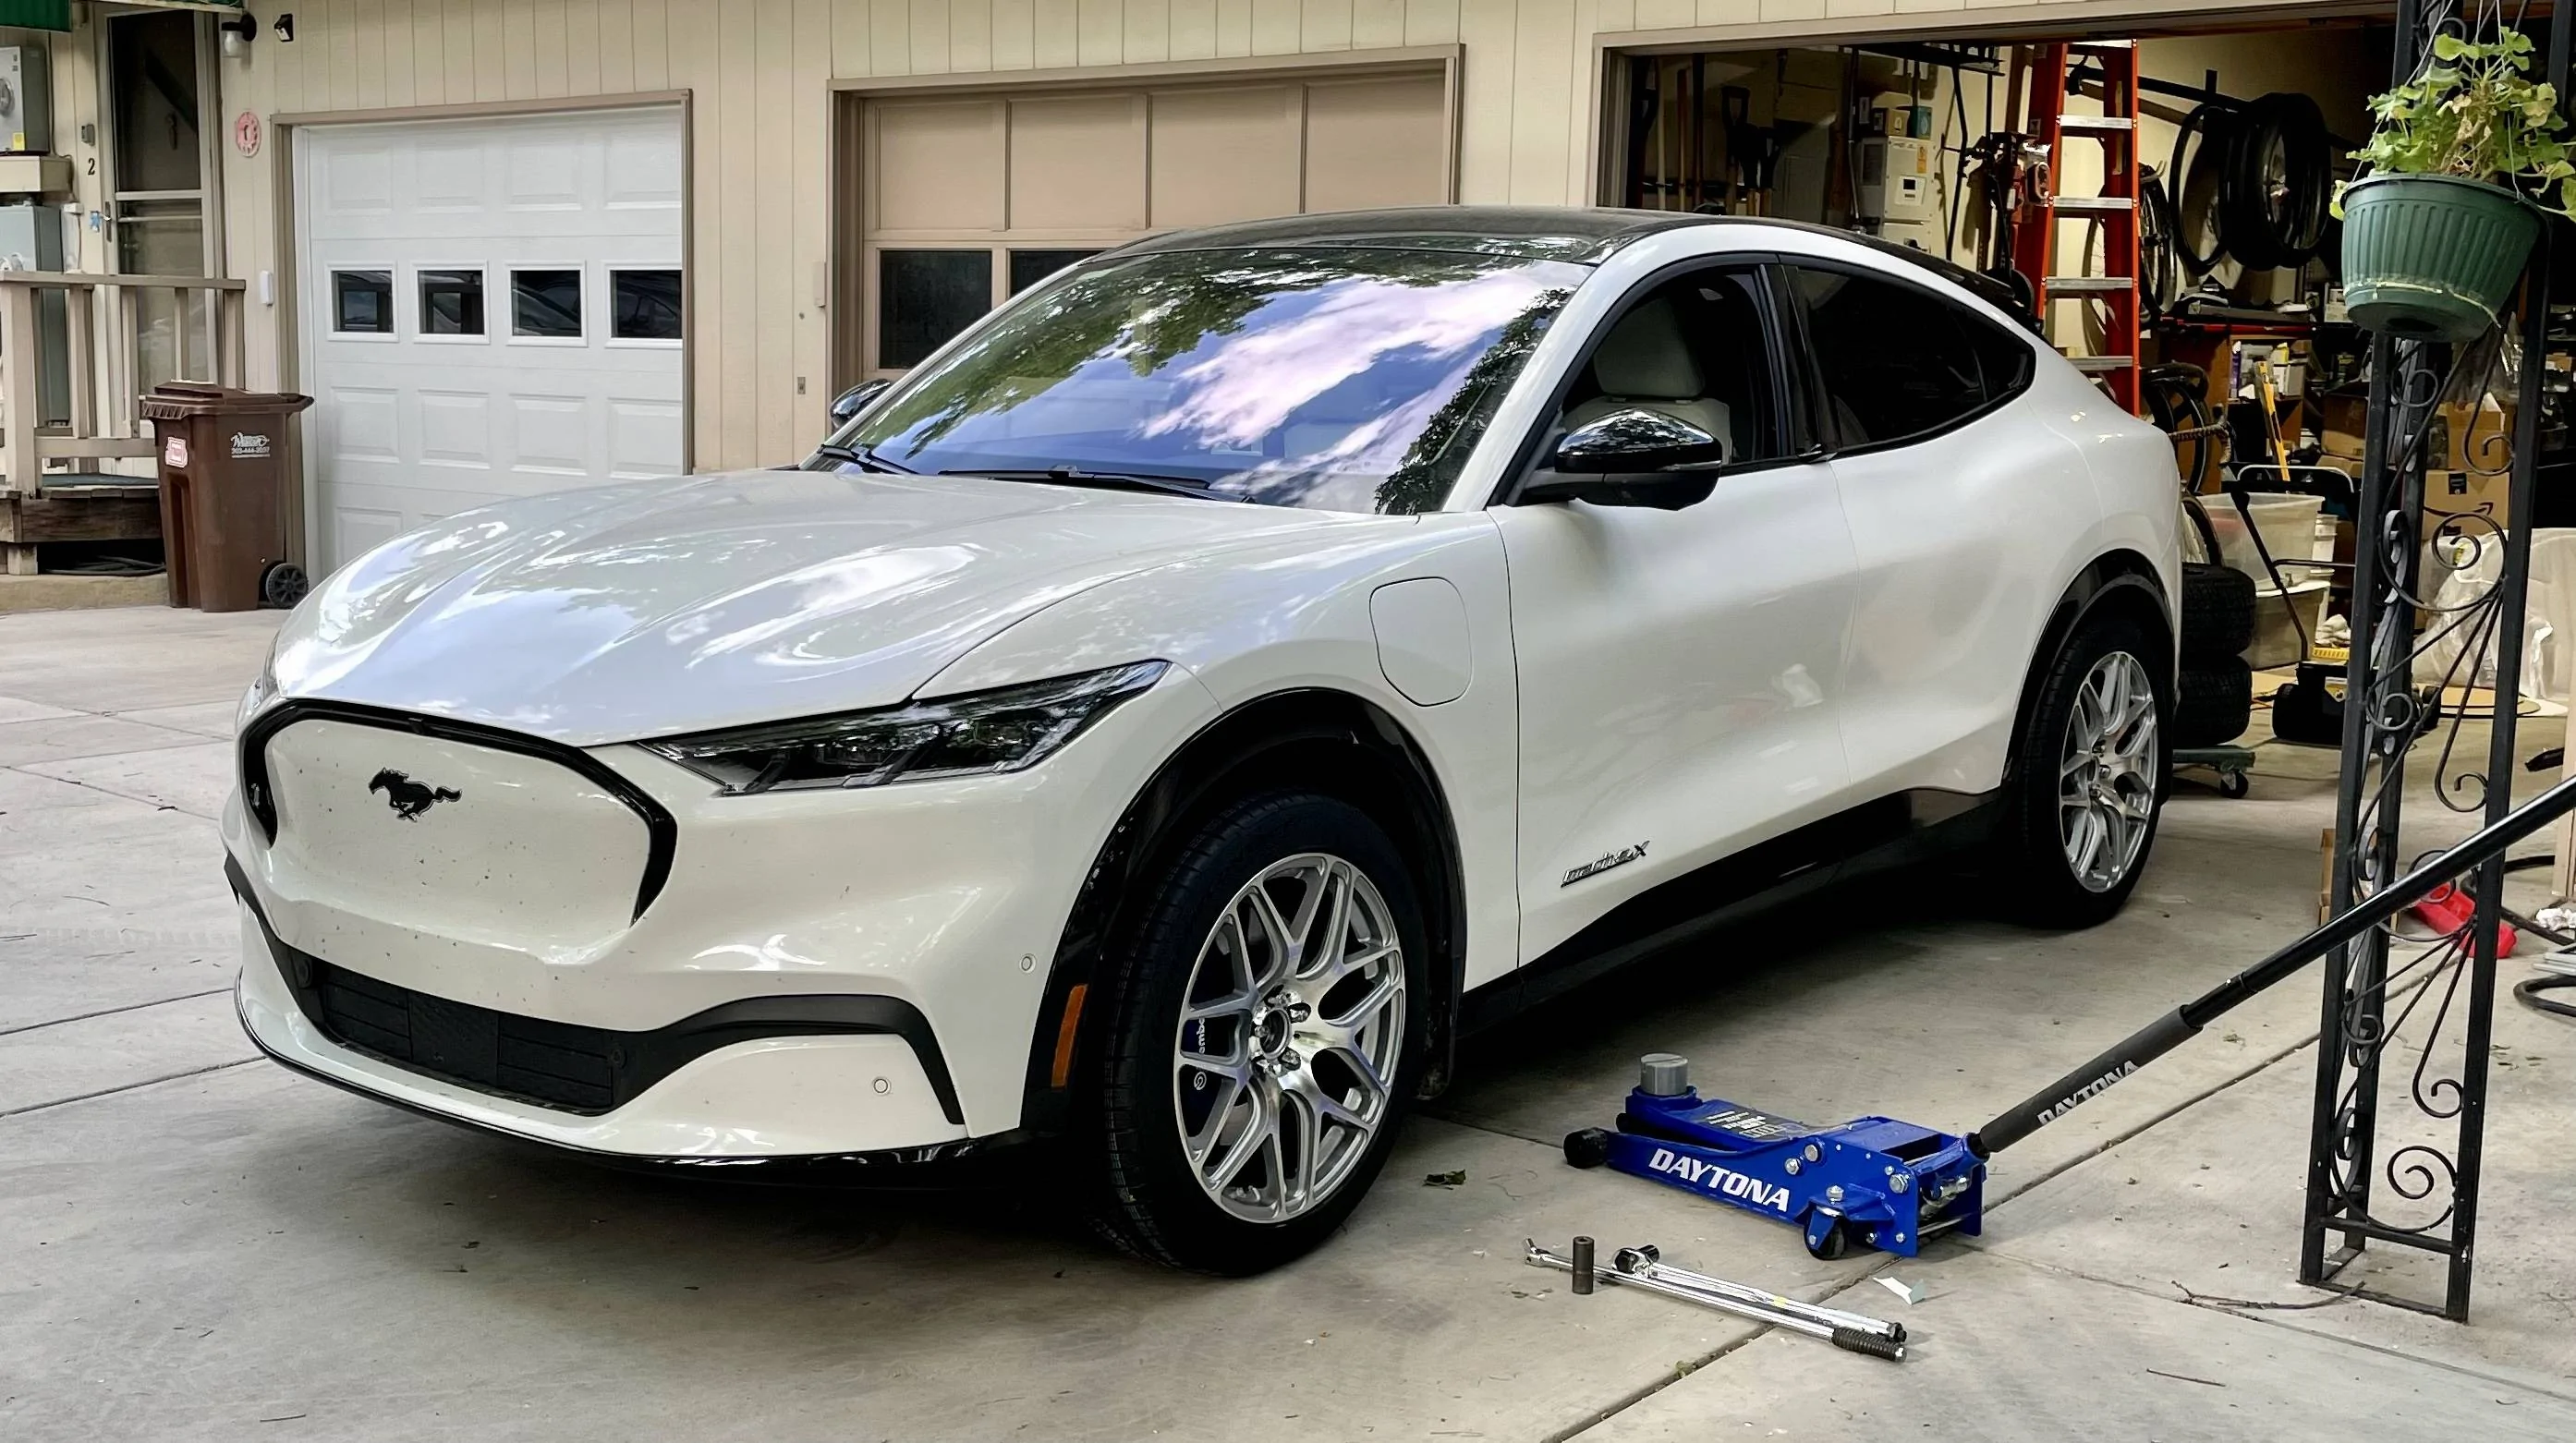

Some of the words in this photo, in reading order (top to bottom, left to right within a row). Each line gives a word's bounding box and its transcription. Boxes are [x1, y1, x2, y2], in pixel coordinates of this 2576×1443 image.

[88, 157, 95, 176] 2
[2036, 1060, 2141, 1125] DAYTONA
[1648, 1147, 1790, 1212] DAYTONA
